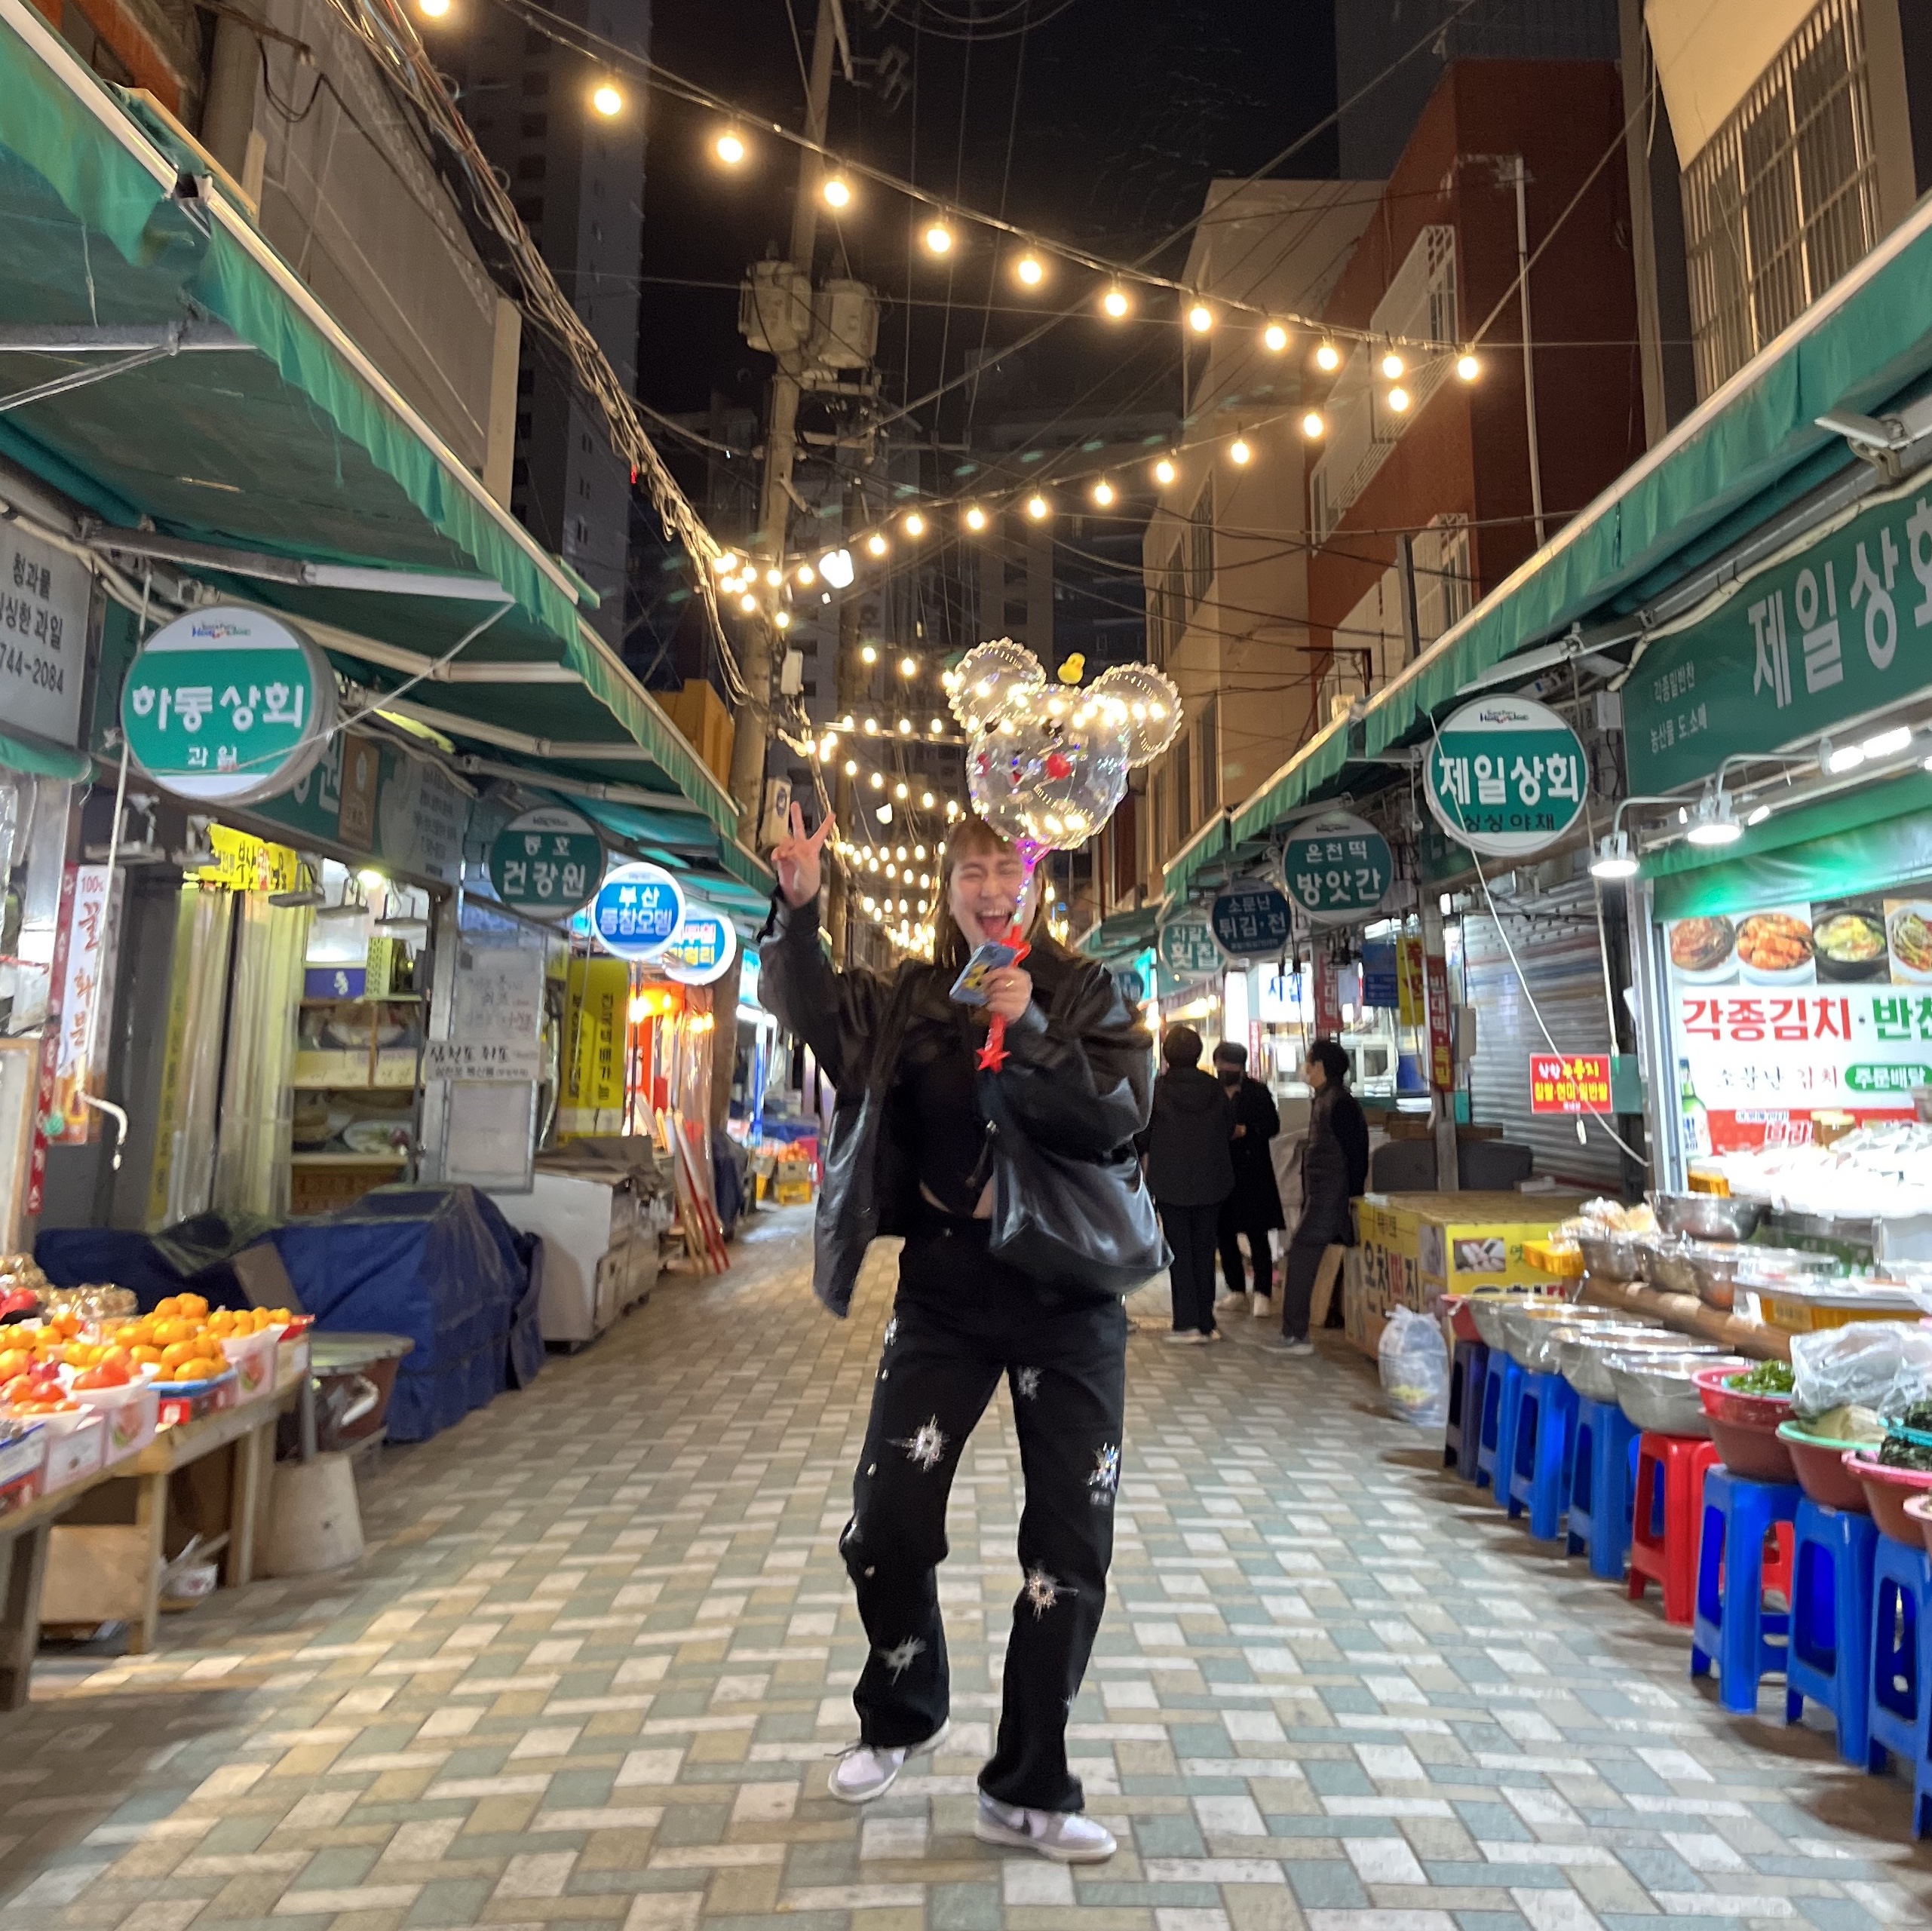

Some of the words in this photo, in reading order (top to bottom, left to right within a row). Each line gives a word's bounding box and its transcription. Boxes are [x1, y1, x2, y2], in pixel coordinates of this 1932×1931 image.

[34, 608, 63, 653] 과일
[132, 682, 304, 732] 하동상회
[1438, 752, 1579, 806] 제일상회
[503, 860, 585, 898] 건강원
[1296, 868, 1381, 906] 방앗간
[619, 886, 660, 913] 부산
[1228, 894, 1271, 913] 소문난
[1172, 926, 1210, 942] 자갈
[1171, 943, 1218, 969] 횟집
[1797, 1065, 1838, 1090] 김치
